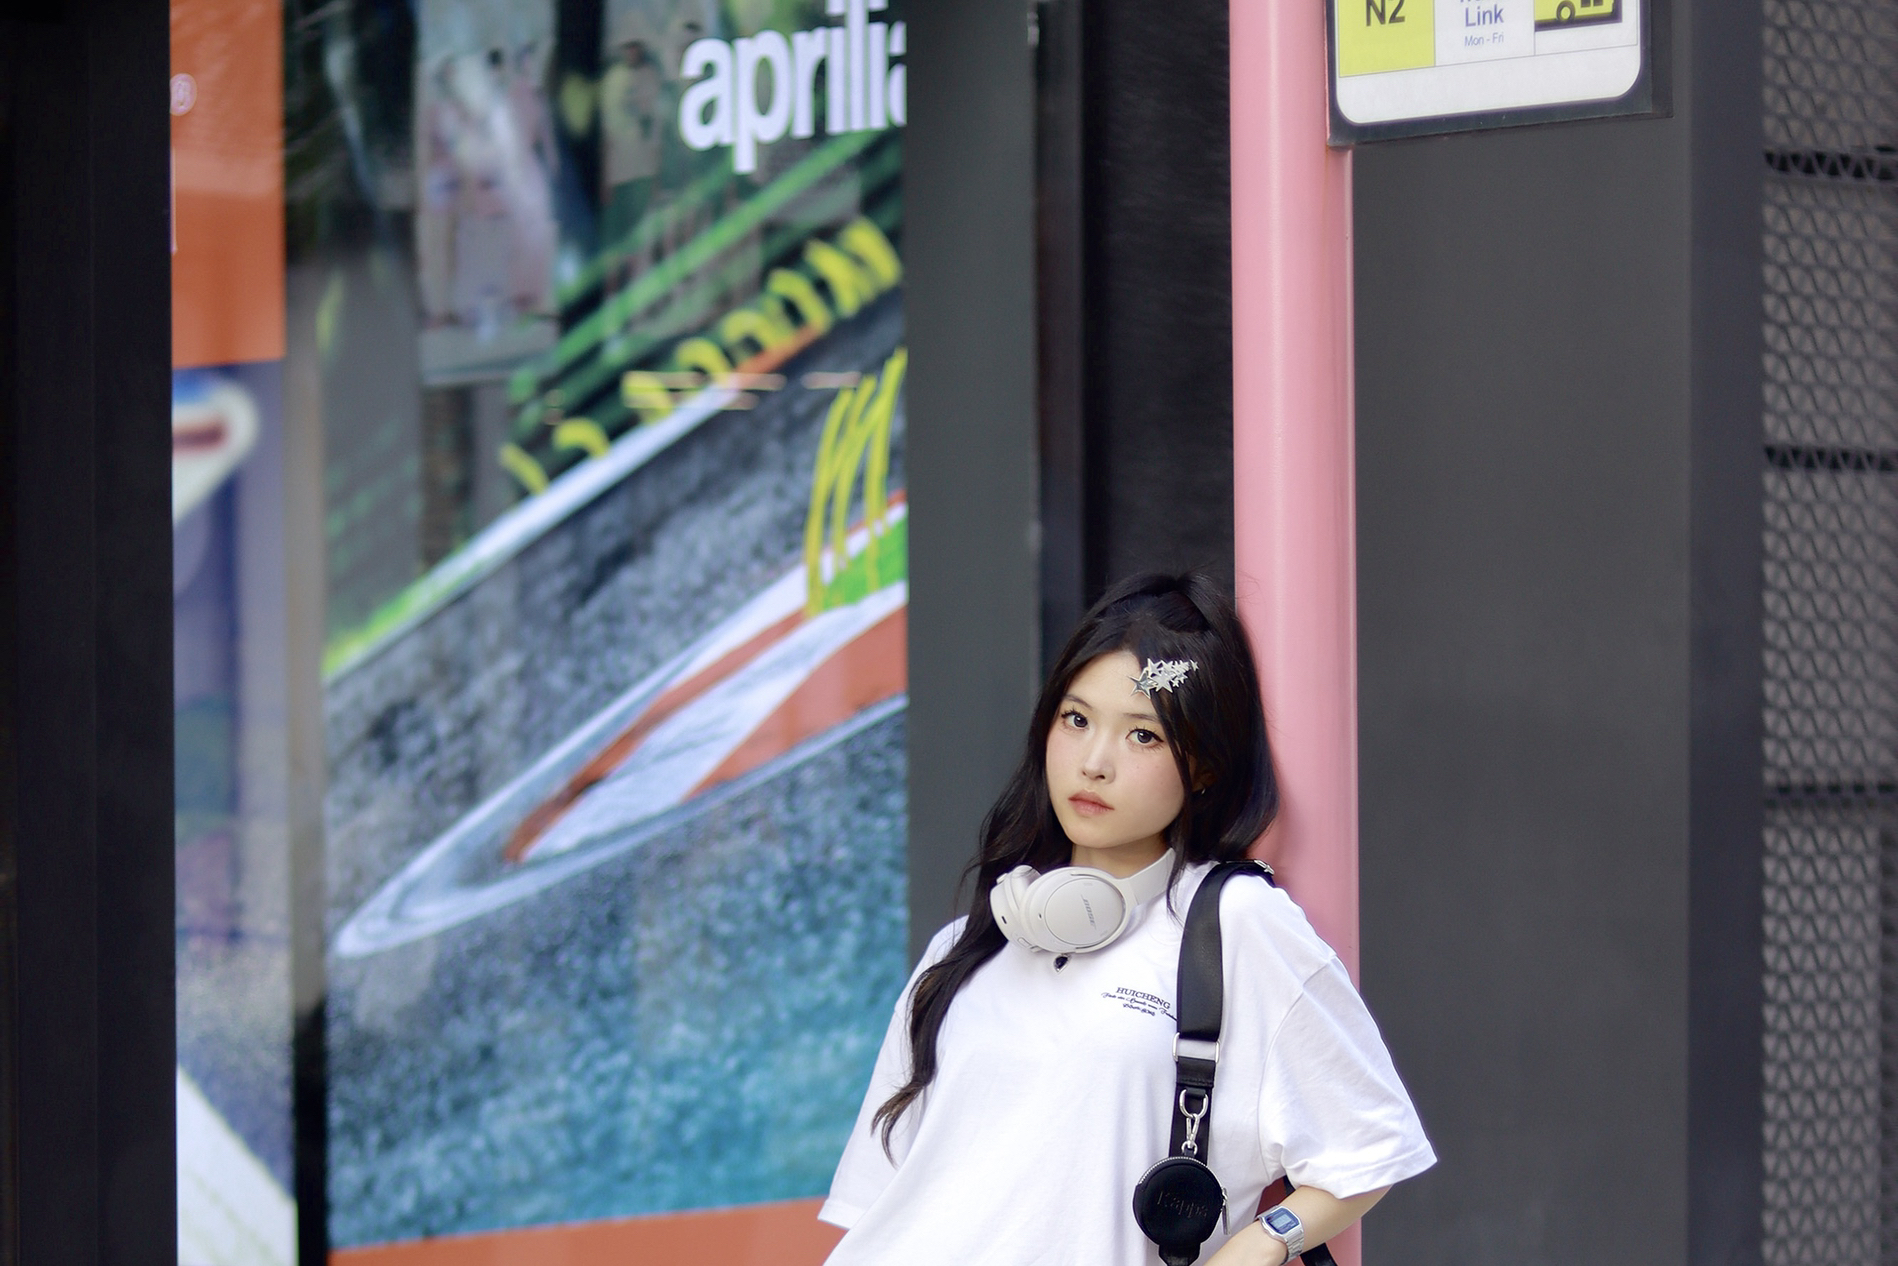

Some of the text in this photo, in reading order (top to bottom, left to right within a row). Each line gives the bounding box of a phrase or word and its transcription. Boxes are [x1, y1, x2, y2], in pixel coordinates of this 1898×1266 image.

[1365, 0, 1406, 27] N2
[1465, 4, 1504, 27] Link
[1464, 35, 1485, 47] Mon
[1492, 31, 1504, 43] Fri
[1080, 894, 1097, 931] BOSE
[1115, 987, 1171, 1010] HUICHENG
